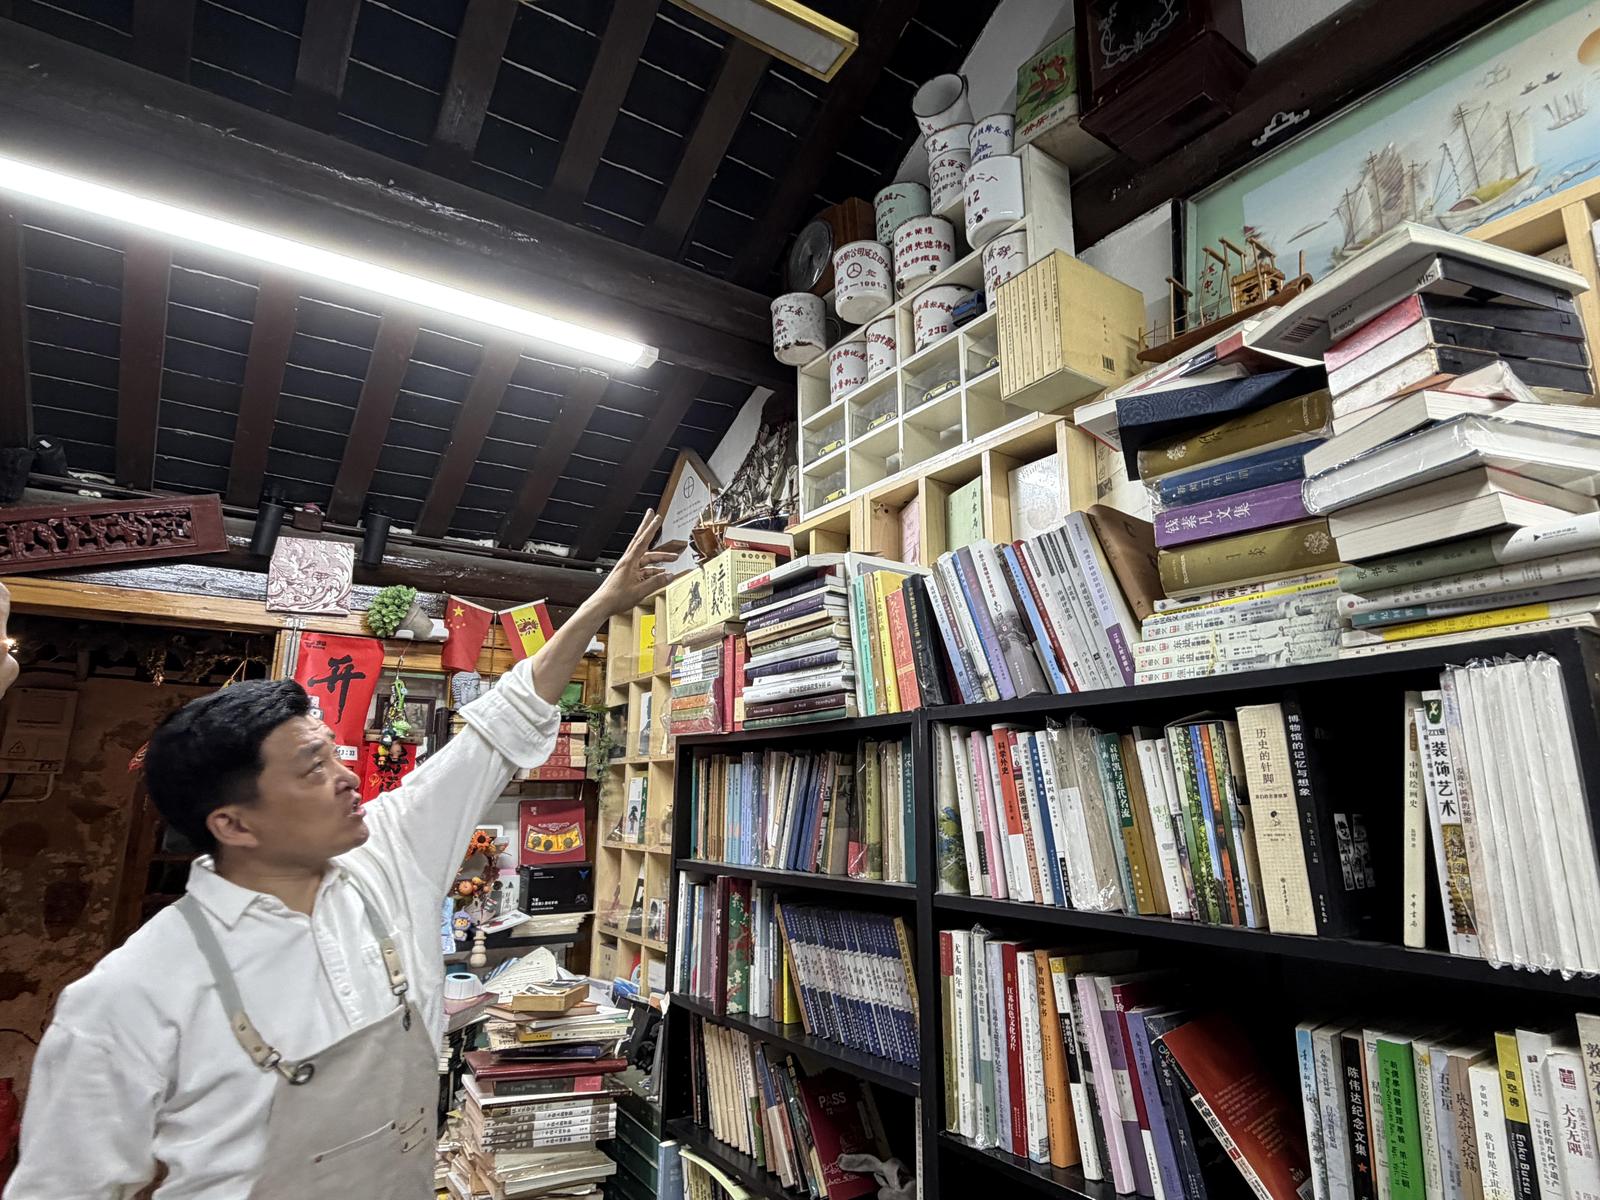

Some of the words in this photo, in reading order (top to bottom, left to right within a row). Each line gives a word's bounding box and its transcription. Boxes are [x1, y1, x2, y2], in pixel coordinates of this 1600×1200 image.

[928, 324, 948, 338] 236
[1165, 501, 1251, 534] 钱素凡文集
[307, 655, 366, 724] 开
[998, 742, 1009, 775] 科学外史
[1109, 743, 1131, 818] 袁世凯与近代名流
[1255, 728, 1275, 784] 历史的针脚
[1288, 714, 1311, 797] 博物馆的记忆与想象
[1430, 740, 1457, 817] 装饰艺术
[1408, 760, 1418, 809] 中国绘画史
[954, 943, 964, 999] 尤无曲年谱
[1037, 966, 1047, 1018] 曾国藩家书
[1113, 993, 1125, 1013] 丁玲
[1347, 1066, 1366, 1157] 陈伟达纪念文集
[1562, 1104, 1584, 1157] 大方无隅
[1484, 1131, 1500, 1200] 我们都是宇宙中
[1515, 1133, 1528, 1162] Enku
[1518, 1163, 1531, 1196] Butsu
